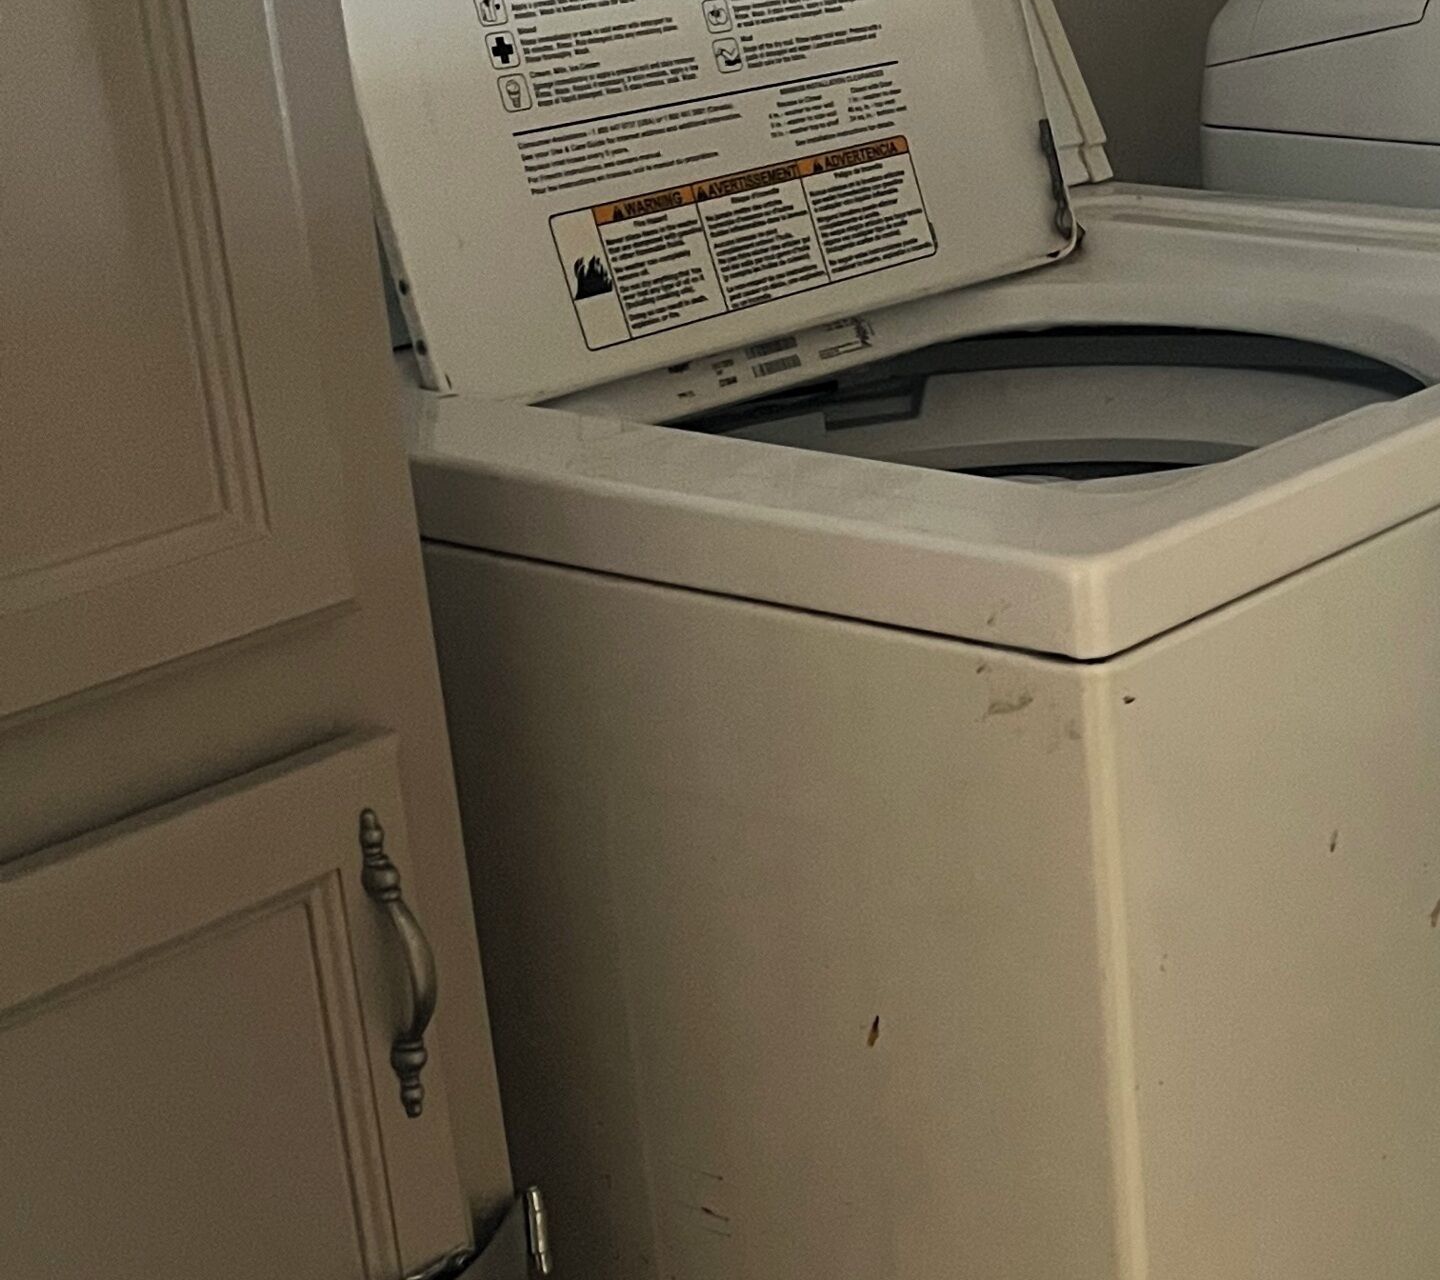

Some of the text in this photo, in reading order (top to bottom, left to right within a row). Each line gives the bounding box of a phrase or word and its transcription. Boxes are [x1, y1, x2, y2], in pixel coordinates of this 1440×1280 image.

[825, 142, 898, 168] ADVERTENCIA
[708, 165, 797, 197] AVERTISSEMENT
[623, 191, 683, 216] WARNING
